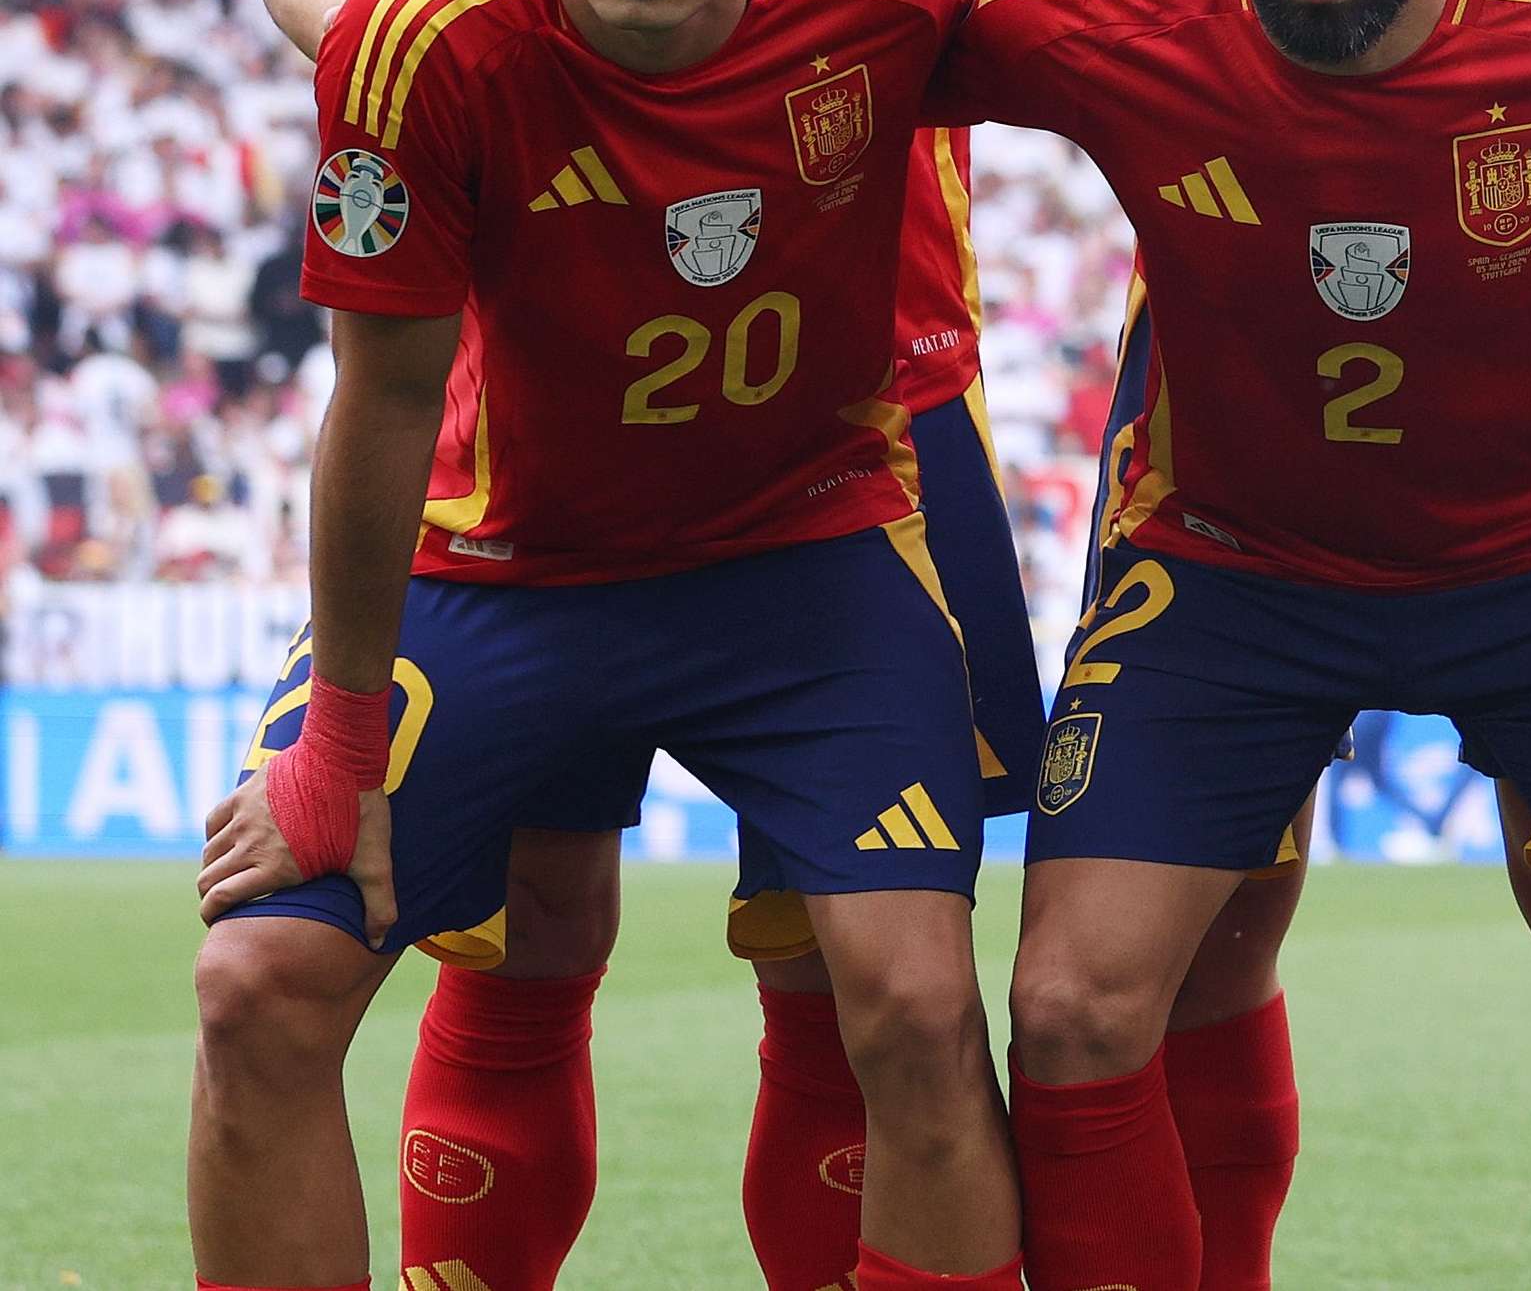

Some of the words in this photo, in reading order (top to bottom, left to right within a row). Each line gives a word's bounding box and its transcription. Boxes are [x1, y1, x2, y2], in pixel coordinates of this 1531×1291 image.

[1373, 227, 1405, 236] LEAGUE
[622, 291, 800, 424] 20
[1317, 342, 1405, 444] 2
[1063, 559, 1175, 689] 2
